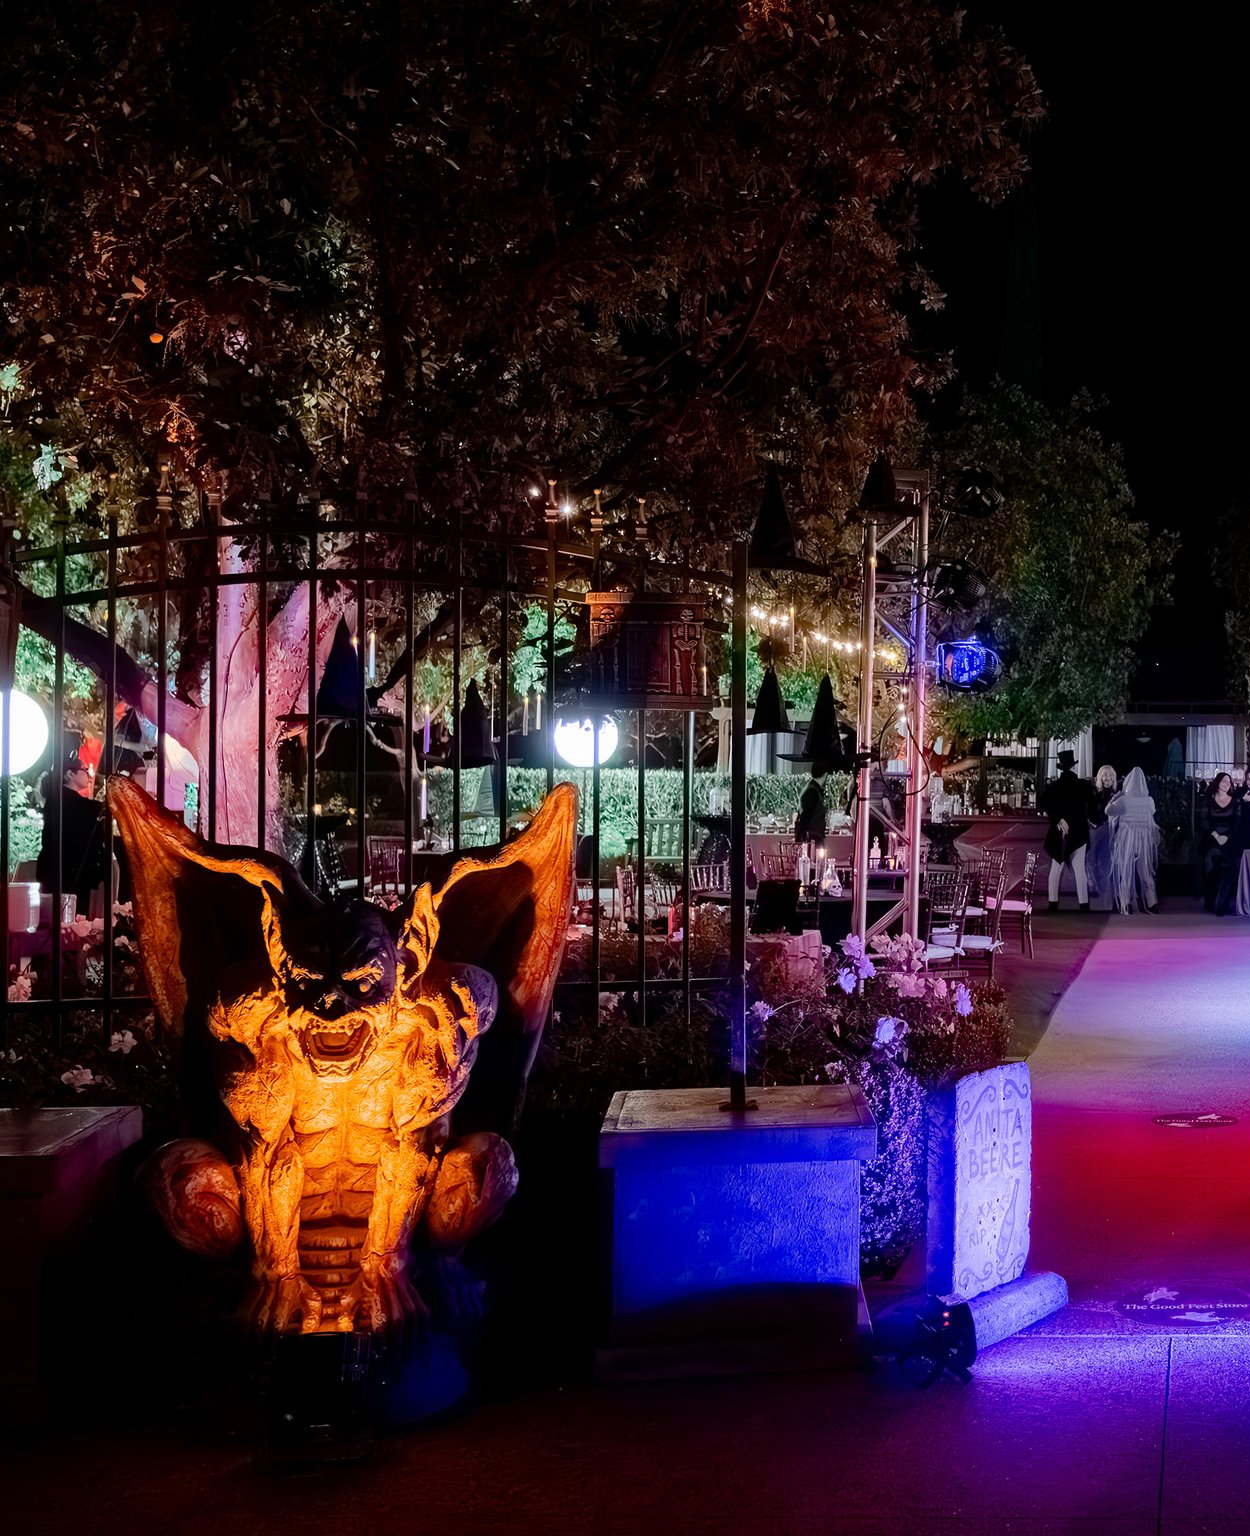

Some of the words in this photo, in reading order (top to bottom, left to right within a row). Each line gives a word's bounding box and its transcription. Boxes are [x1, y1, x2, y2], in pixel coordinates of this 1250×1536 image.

[973, 1107, 1024, 1147] ANITA
[968, 1141, 1025, 1178] BEERE
[968, 1228, 987, 1249] RIP
